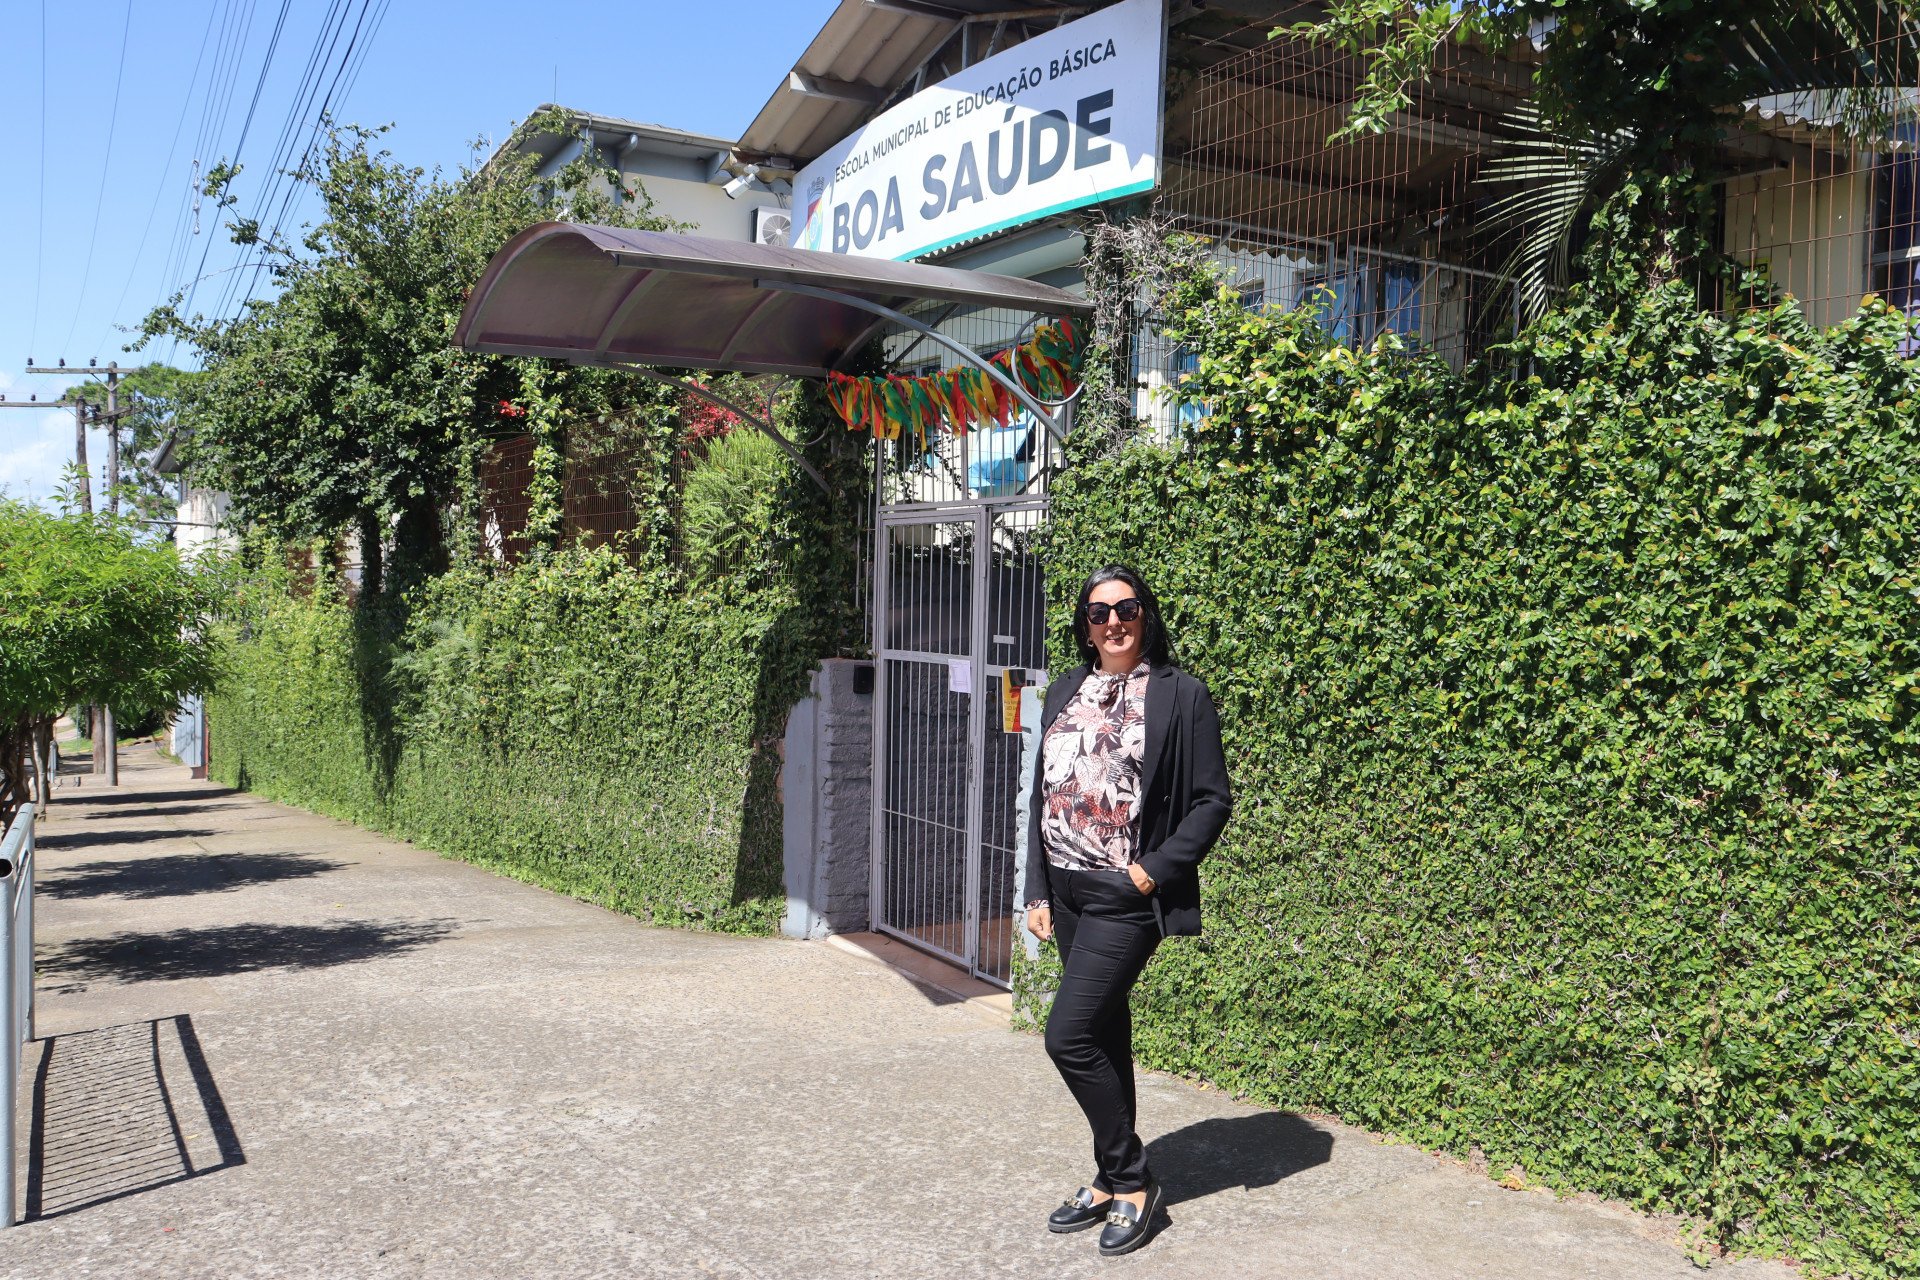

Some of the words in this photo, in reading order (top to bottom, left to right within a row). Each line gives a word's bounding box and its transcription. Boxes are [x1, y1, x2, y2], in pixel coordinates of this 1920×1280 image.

[832, 175, 905, 255] BOA
[919, 88, 1114, 221] SAÚDE
[835, 150, 870, 183] ESCOLA
[872, 117, 929, 162] MUNICIPAL
[934, 106, 952, 129] DE
[956, 66, 1043, 119] EDUCAÇÃO
[1049, 38, 1117, 81] BÁSICA
